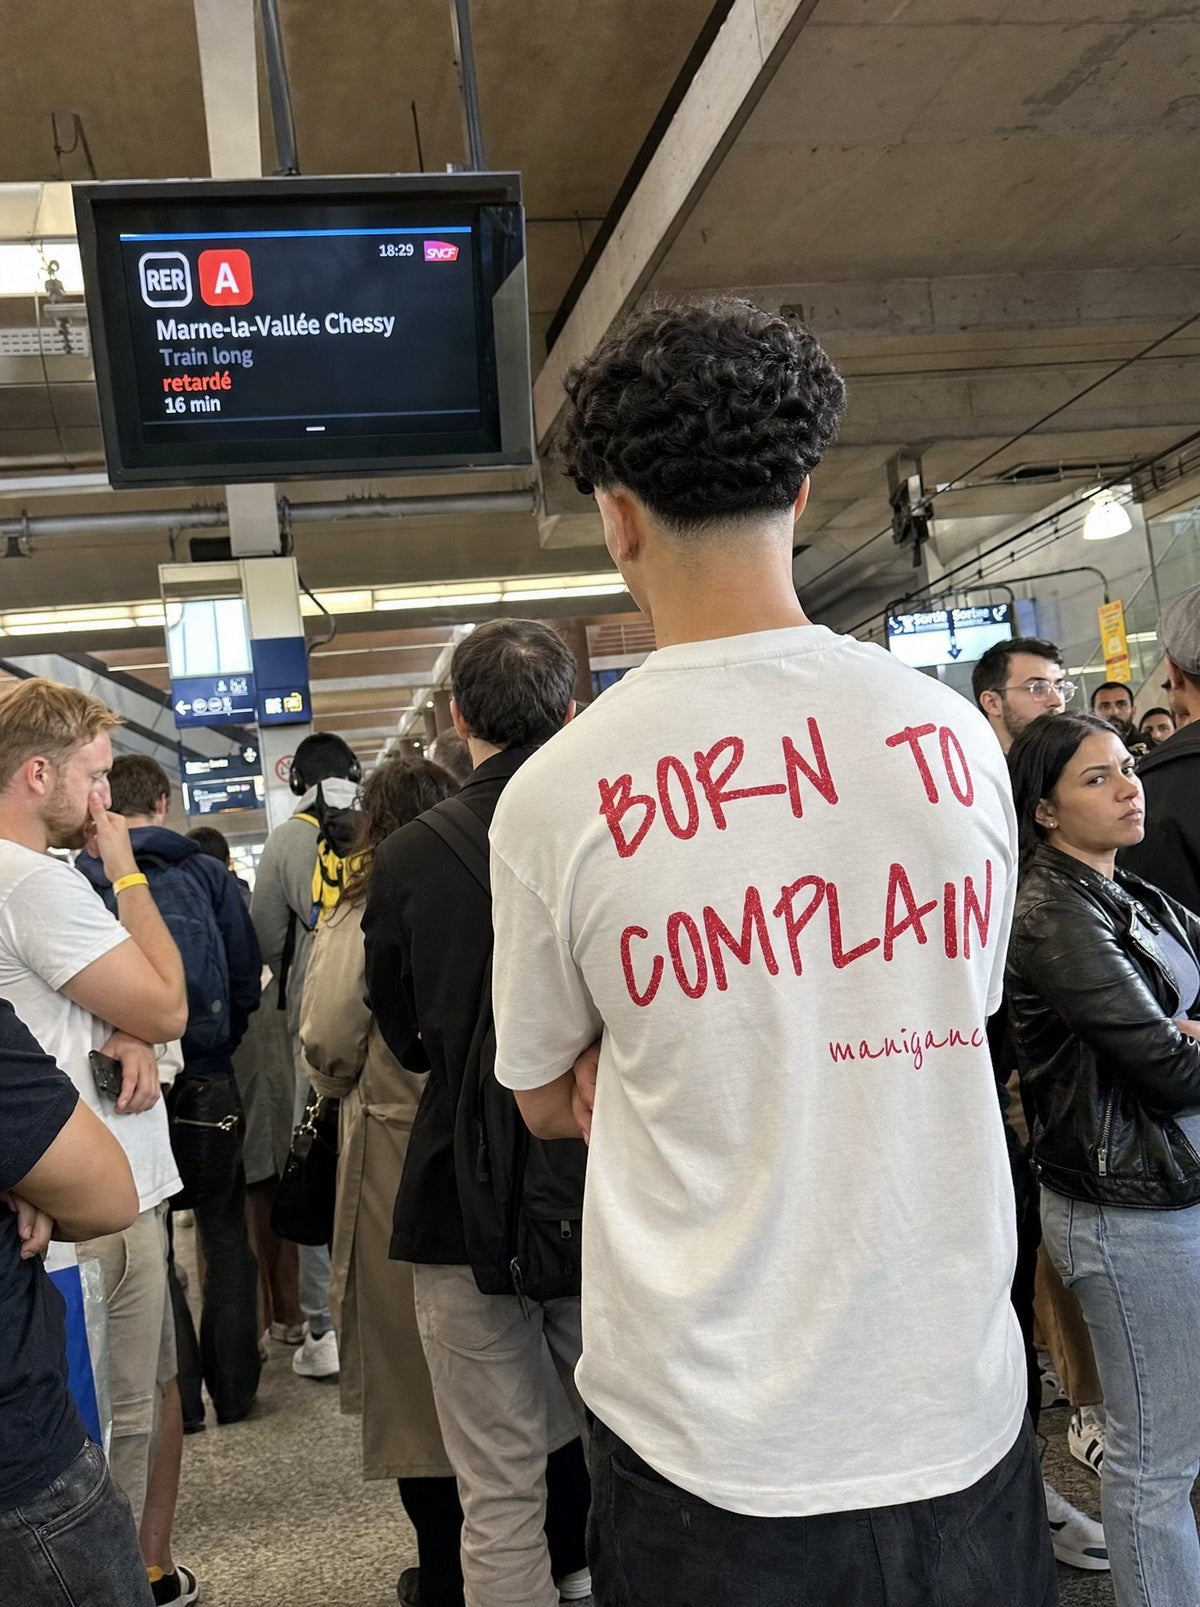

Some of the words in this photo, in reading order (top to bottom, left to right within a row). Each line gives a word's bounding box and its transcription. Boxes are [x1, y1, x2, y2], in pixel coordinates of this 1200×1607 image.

[379, 242, 414, 257] 18:29
[426, 243, 456, 260] SNCF
[146, 268, 185, 292] RER
[215, 263, 240, 294] A
[156, 313, 320, 341] Marne-la-Vallée
[324, 312, 396, 337] Chessy
[159, 347, 208, 367] Train
[213, 346, 254, 368] long
[162, 371, 232, 392] retardé
[165, 396, 186, 413] 16
[190, 395, 221, 412] min
[597, 716, 840, 859] BORN
[886, 722, 974, 807] TO
[617, 858, 993, 1008] COMPLAIN
[829, 1028, 987, 1070] maniganc
